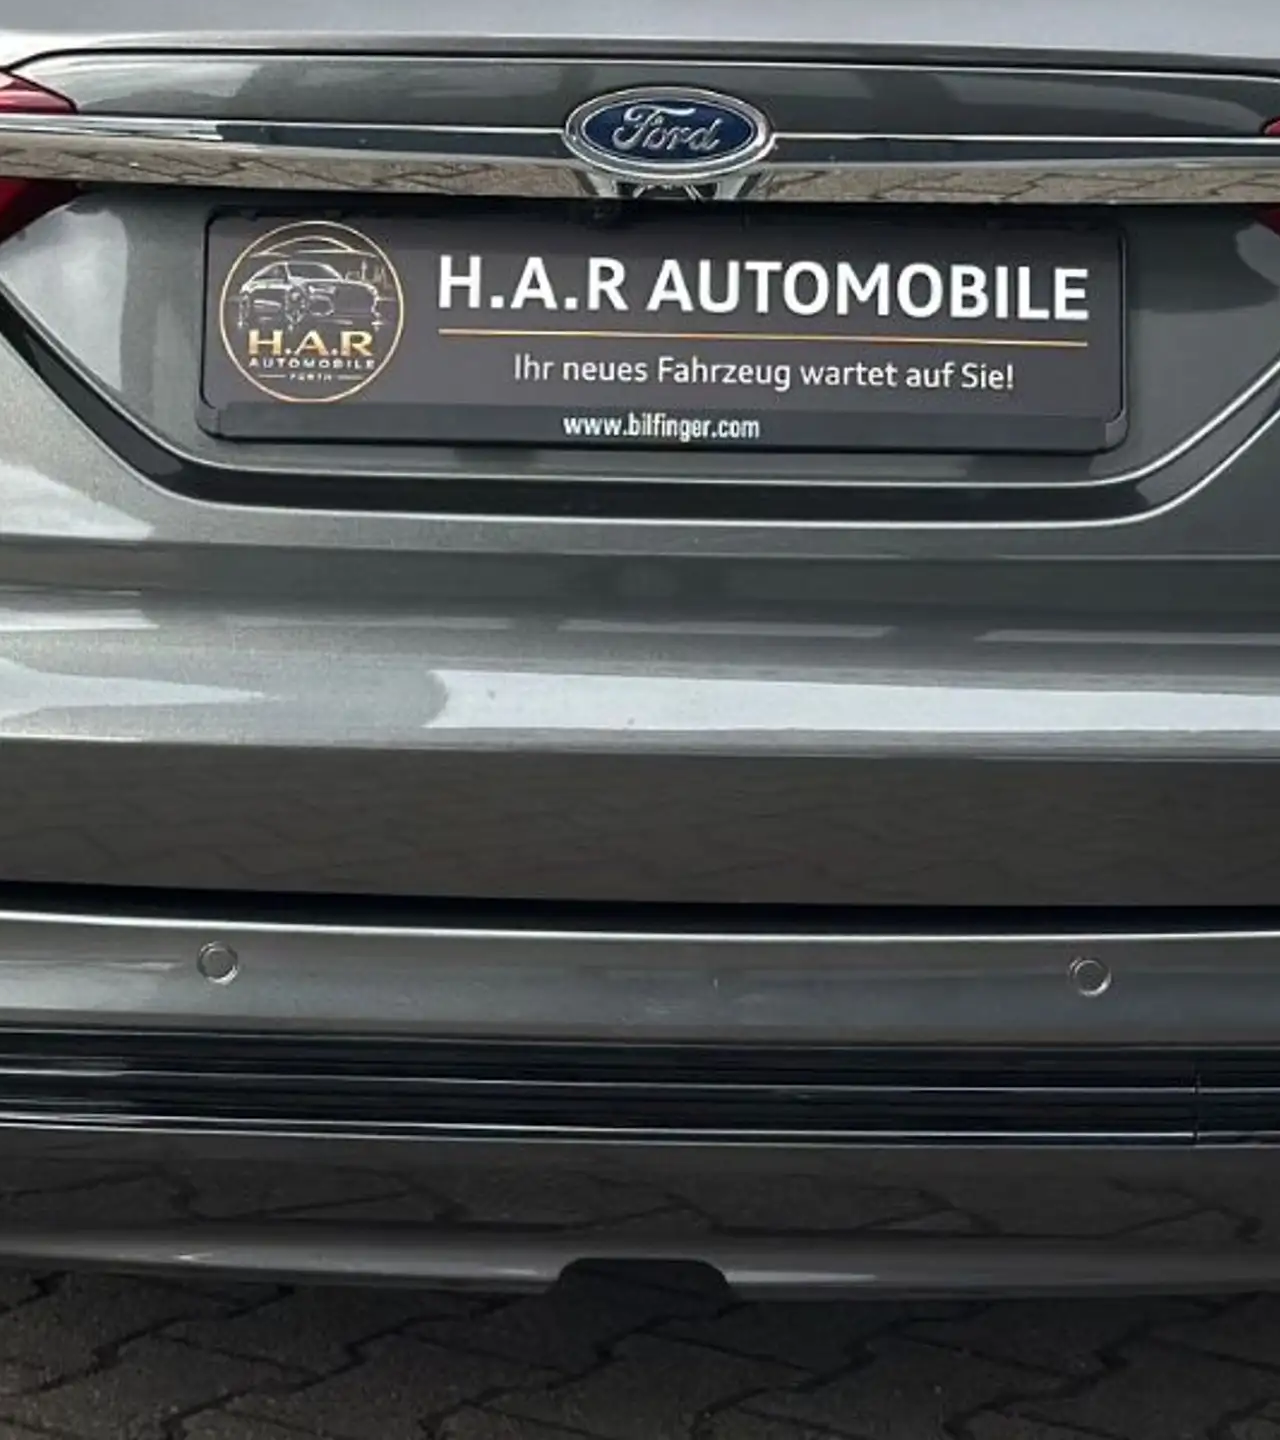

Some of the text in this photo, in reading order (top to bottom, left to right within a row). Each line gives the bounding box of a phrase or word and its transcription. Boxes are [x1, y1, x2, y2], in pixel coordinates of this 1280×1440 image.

[610, 103, 724, 151] Ford
[438, 254, 1090, 321] H.A.R AUTOMOBILE
[248, 328, 374, 357] H.A.R
[248, 357, 376, 369] AUTOMOBILE
[514, 353, 1014, 392] Ihr neues Fahrzeug wartet auf Sie!
[562, 412, 761, 443] www.bilfinger.com
